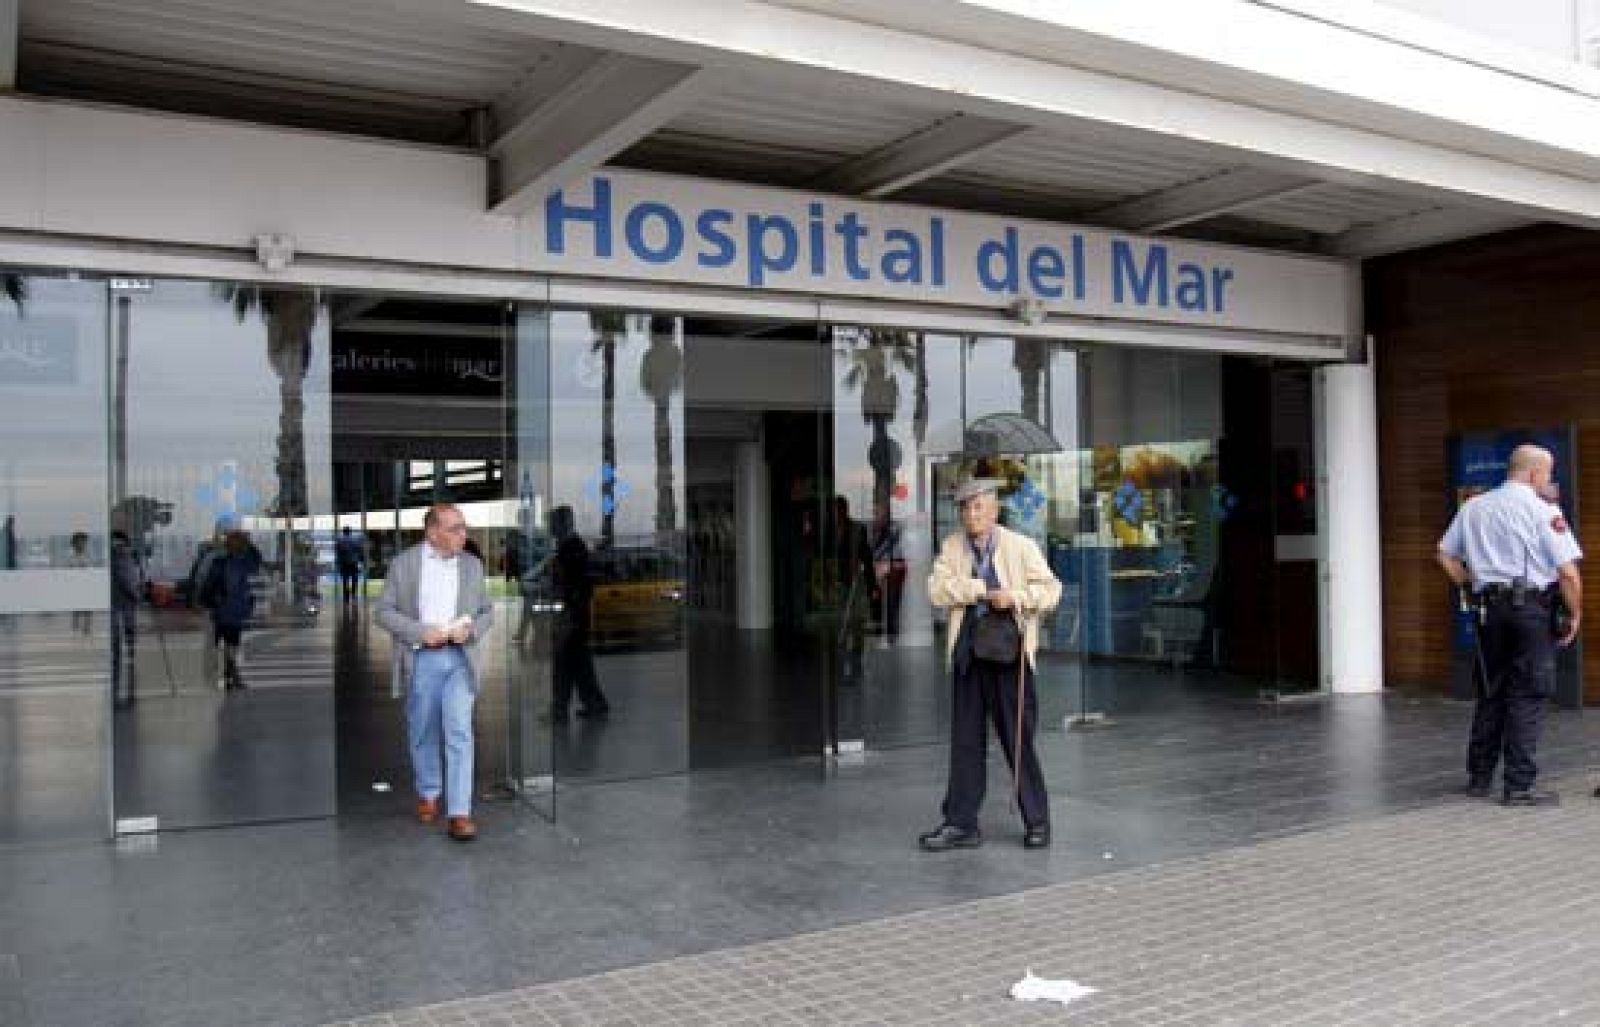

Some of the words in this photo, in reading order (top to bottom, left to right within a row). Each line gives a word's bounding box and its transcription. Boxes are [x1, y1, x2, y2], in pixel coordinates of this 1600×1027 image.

[546, 176, 945, 286] Hospital
[977, 230, 1085, 299] del
[1112, 240, 1234, 313] Mar
[333, 349, 416, 372] aleries
